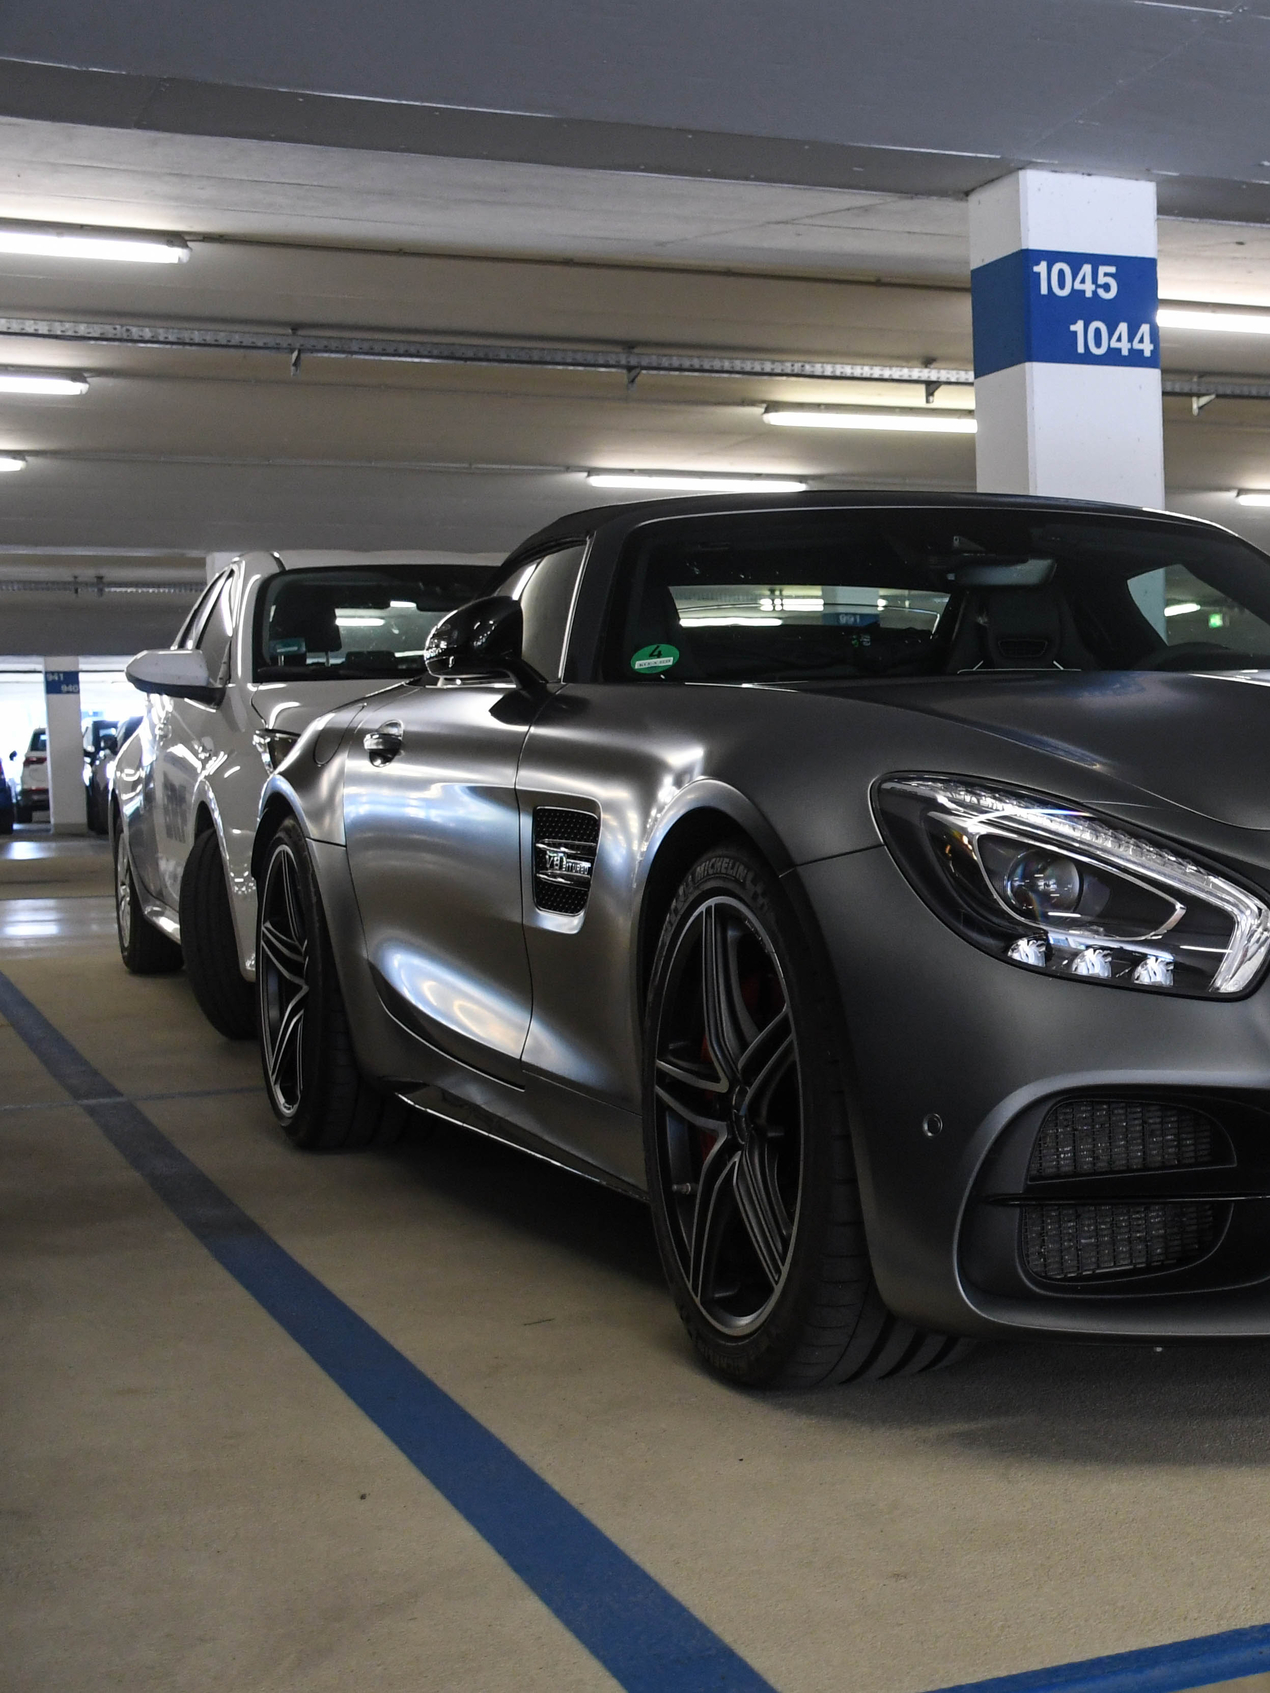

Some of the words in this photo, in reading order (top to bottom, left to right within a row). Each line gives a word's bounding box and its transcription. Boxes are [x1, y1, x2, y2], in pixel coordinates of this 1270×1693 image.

[1032, 260, 1118, 299] 1045
[1069, 320, 1154, 357] 1044
[649, 645, 662, 658] 4
[695, 857, 747, 882] MICHELIN
